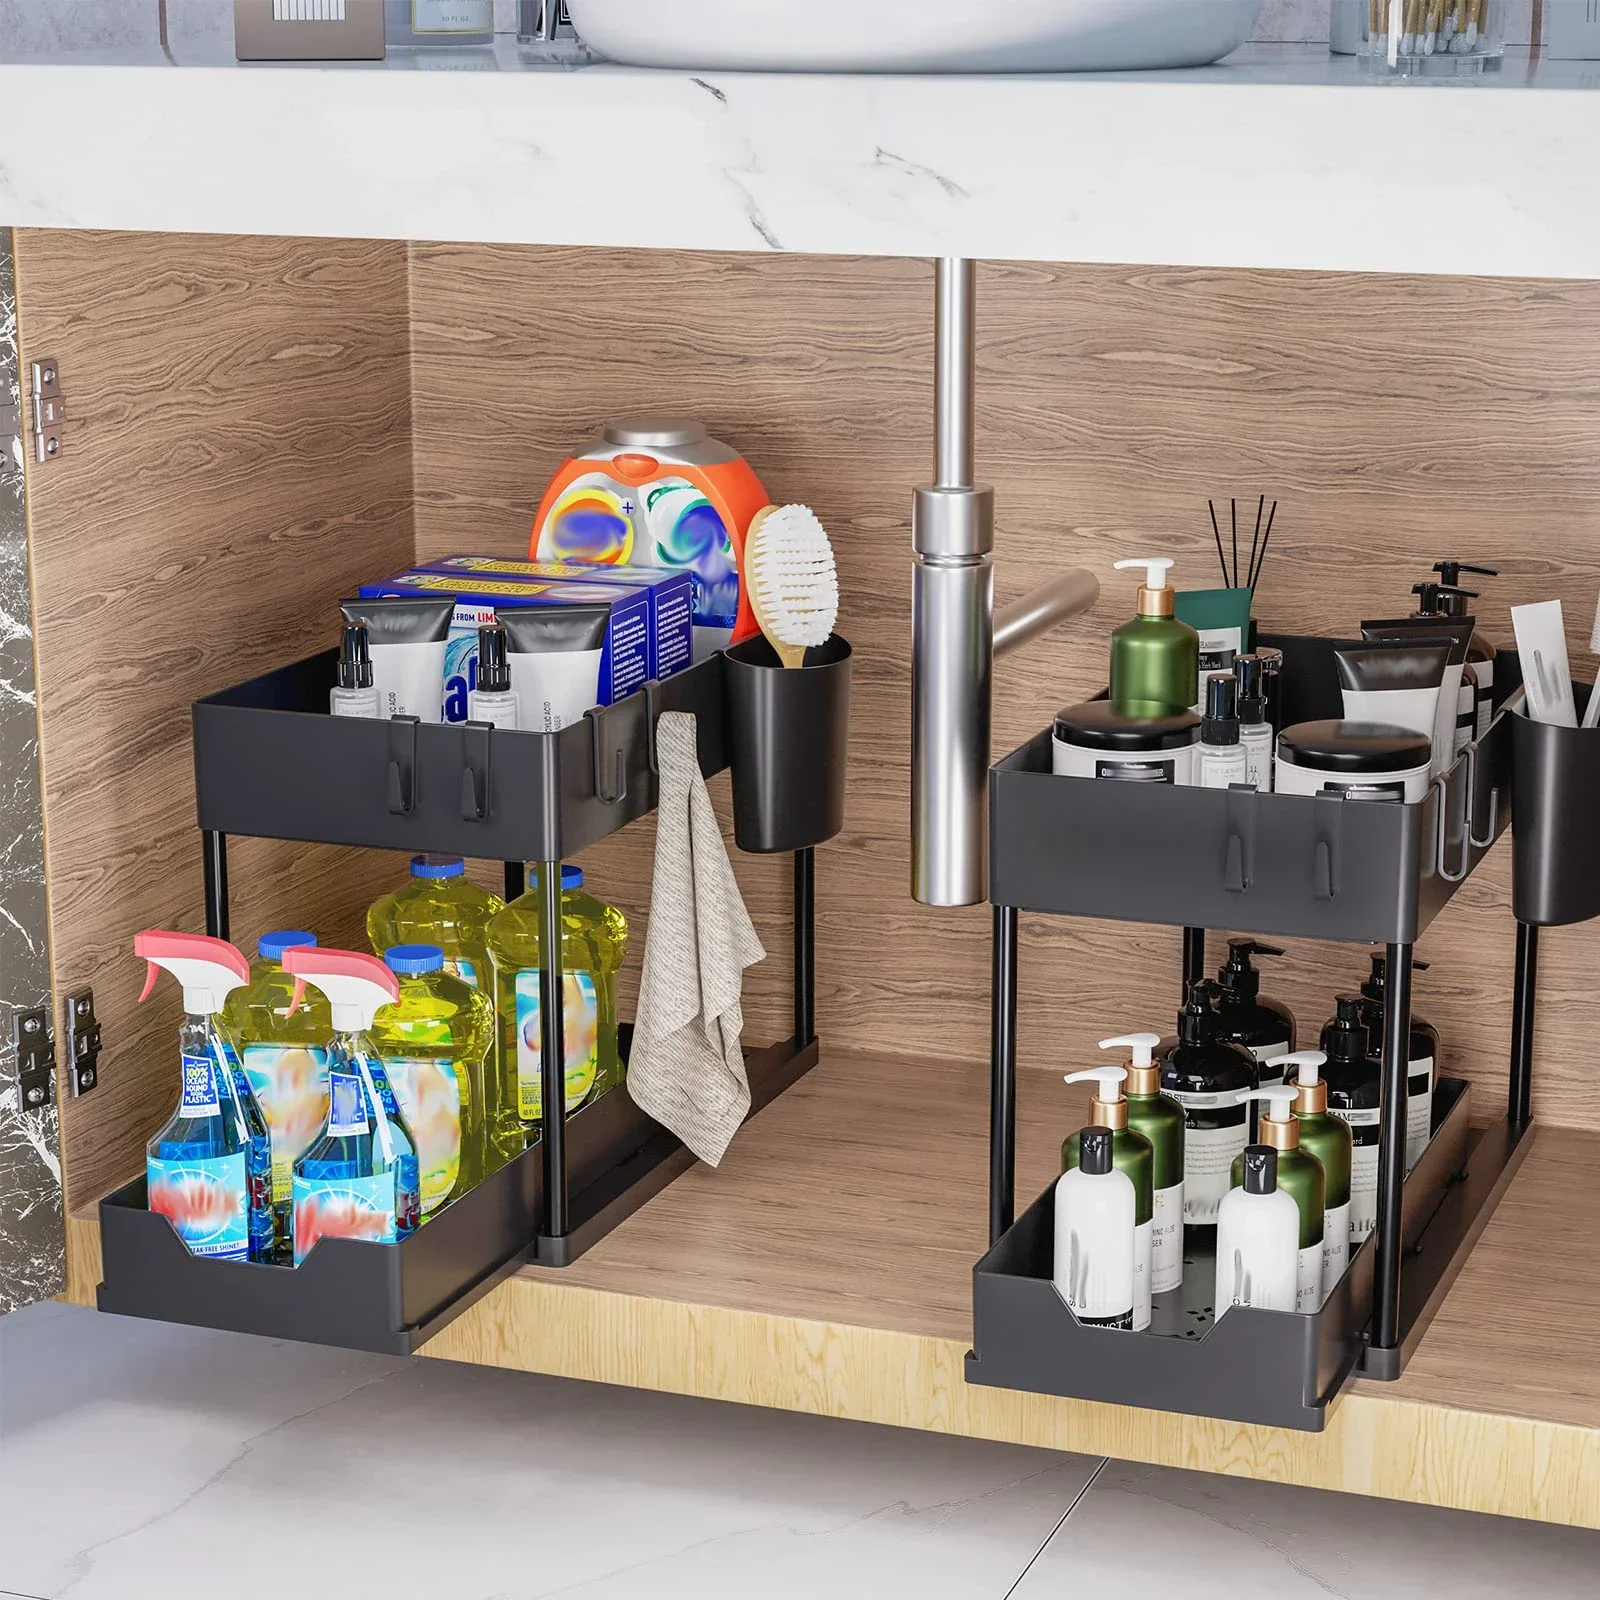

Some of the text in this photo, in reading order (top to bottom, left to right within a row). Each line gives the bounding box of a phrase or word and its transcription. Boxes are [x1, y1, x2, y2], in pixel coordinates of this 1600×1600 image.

[456, 612, 475, 622] FROM
[543, 701, 552, 716] ACID
[185, 1066, 209, 1078] 100%
[185, 1077, 209, 1085] OCEAN
[185, 1084, 208, 1092] BOUND
[184, 1095, 212, 1104] PLASTIC
